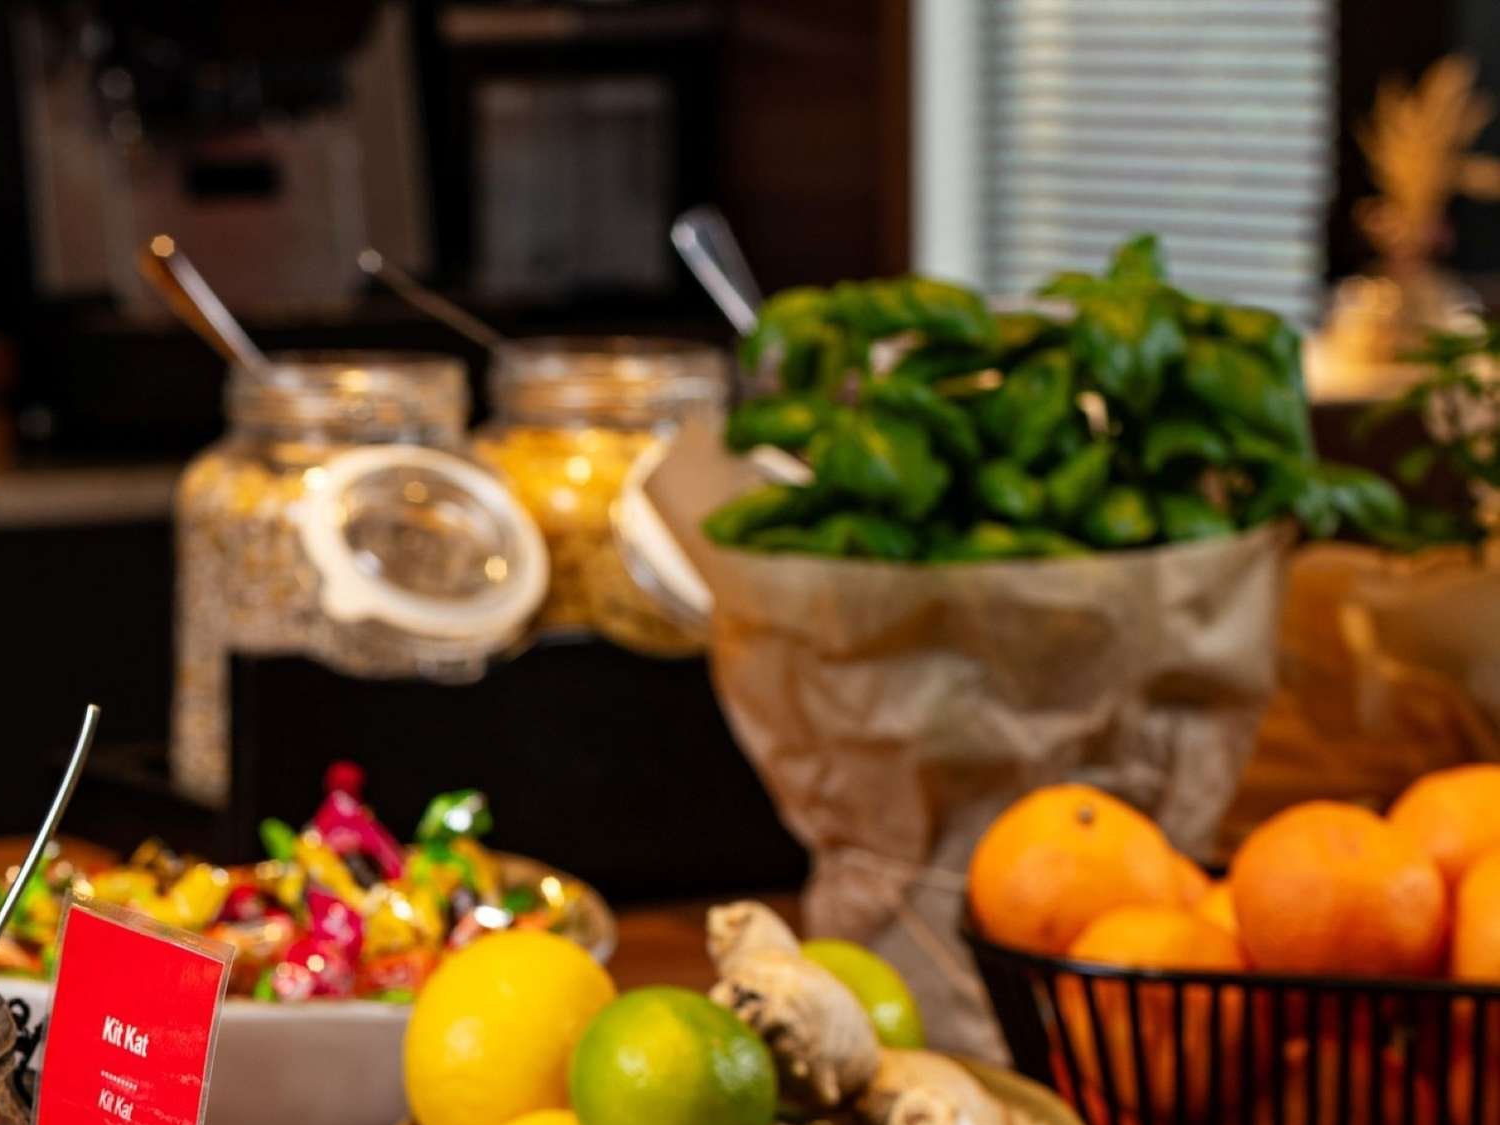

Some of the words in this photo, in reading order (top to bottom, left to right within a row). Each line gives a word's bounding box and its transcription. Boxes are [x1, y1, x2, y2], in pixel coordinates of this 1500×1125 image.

[102, 1016, 123, 1047] Kit
[123, 1024, 149, 1058] Kat
[98, 1088, 115, 1113] Kit
[114, 1095, 134, 1121] Kat
